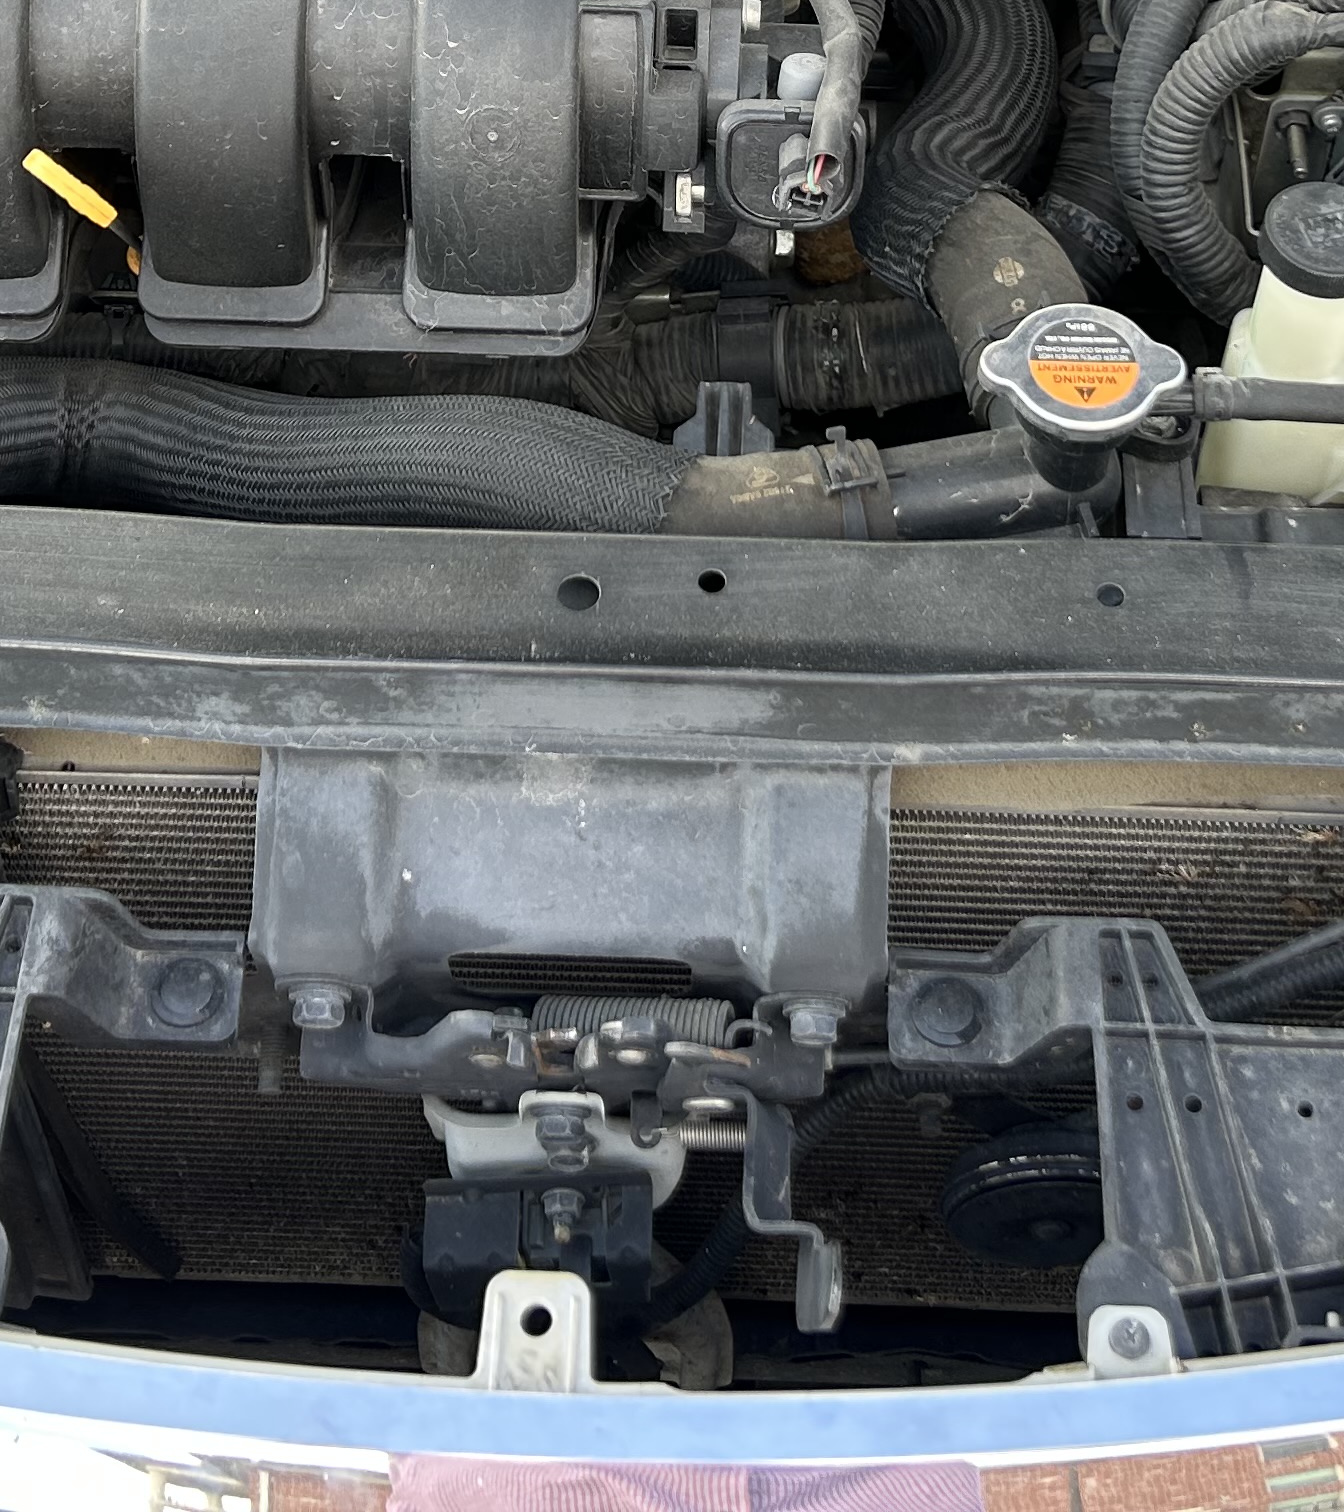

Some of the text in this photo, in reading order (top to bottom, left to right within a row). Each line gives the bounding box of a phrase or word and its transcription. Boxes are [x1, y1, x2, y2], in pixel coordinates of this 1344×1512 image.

[1054, 353, 1079, 361] WHEN
[1080, 353, 1102, 361] OPEN
[1103, 353, 1130, 361] NEVER
[1037, 363, 1131, 373] AVERTISSEMENT
[1052, 374, 1117, 385] WARNING
